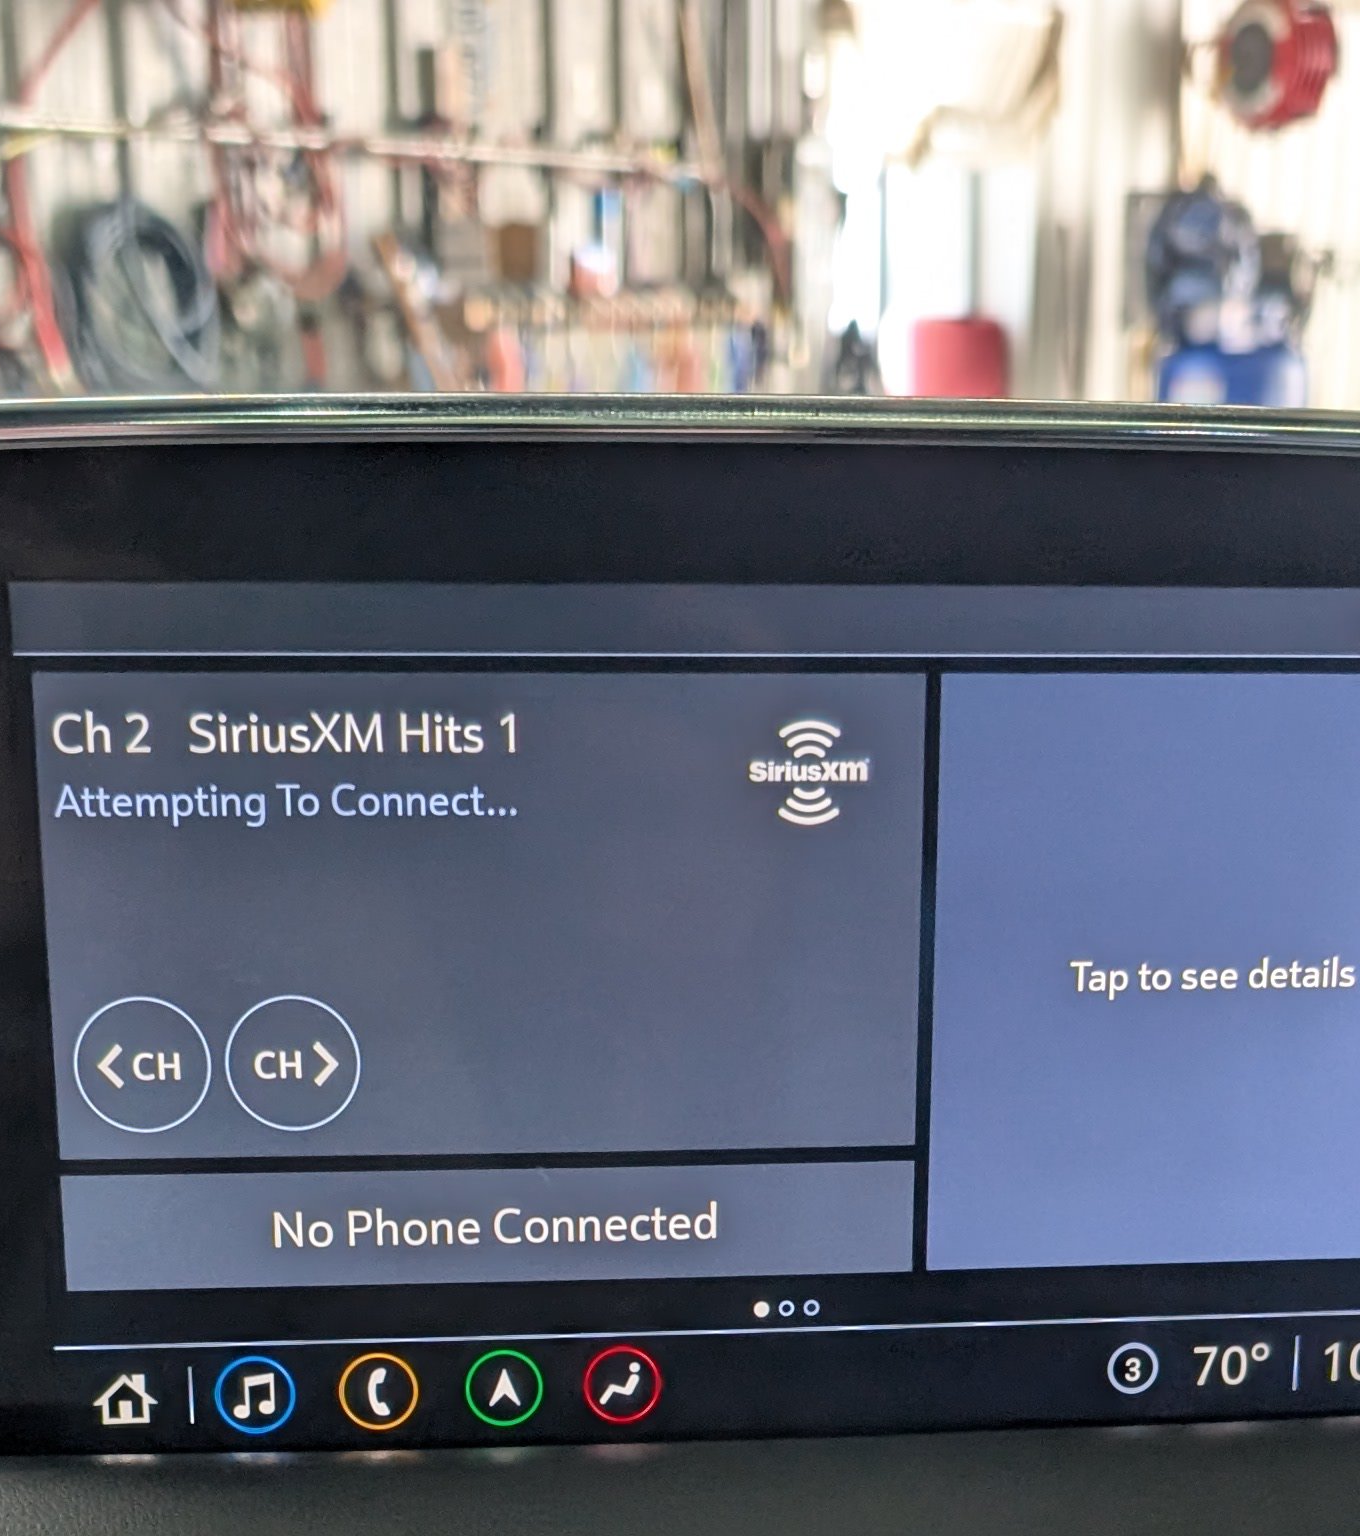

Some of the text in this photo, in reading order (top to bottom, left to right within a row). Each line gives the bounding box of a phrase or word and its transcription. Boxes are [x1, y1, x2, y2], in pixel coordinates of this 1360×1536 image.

[54, 711, 515, 753] Ch 2 SiriusXM Hits 1
[55, 784, 517, 827] Attempting To Connect...
[1071, 956, 1355, 1000] Tap to see details
[133, 1053, 181, 1080] CH
[255, 1051, 302, 1079] CH
[274, 1201, 717, 1247] No Phone Connected
[1124, 1358, 1140, 1381] 3
[1194, 1343, 1269, 1385] 70°
